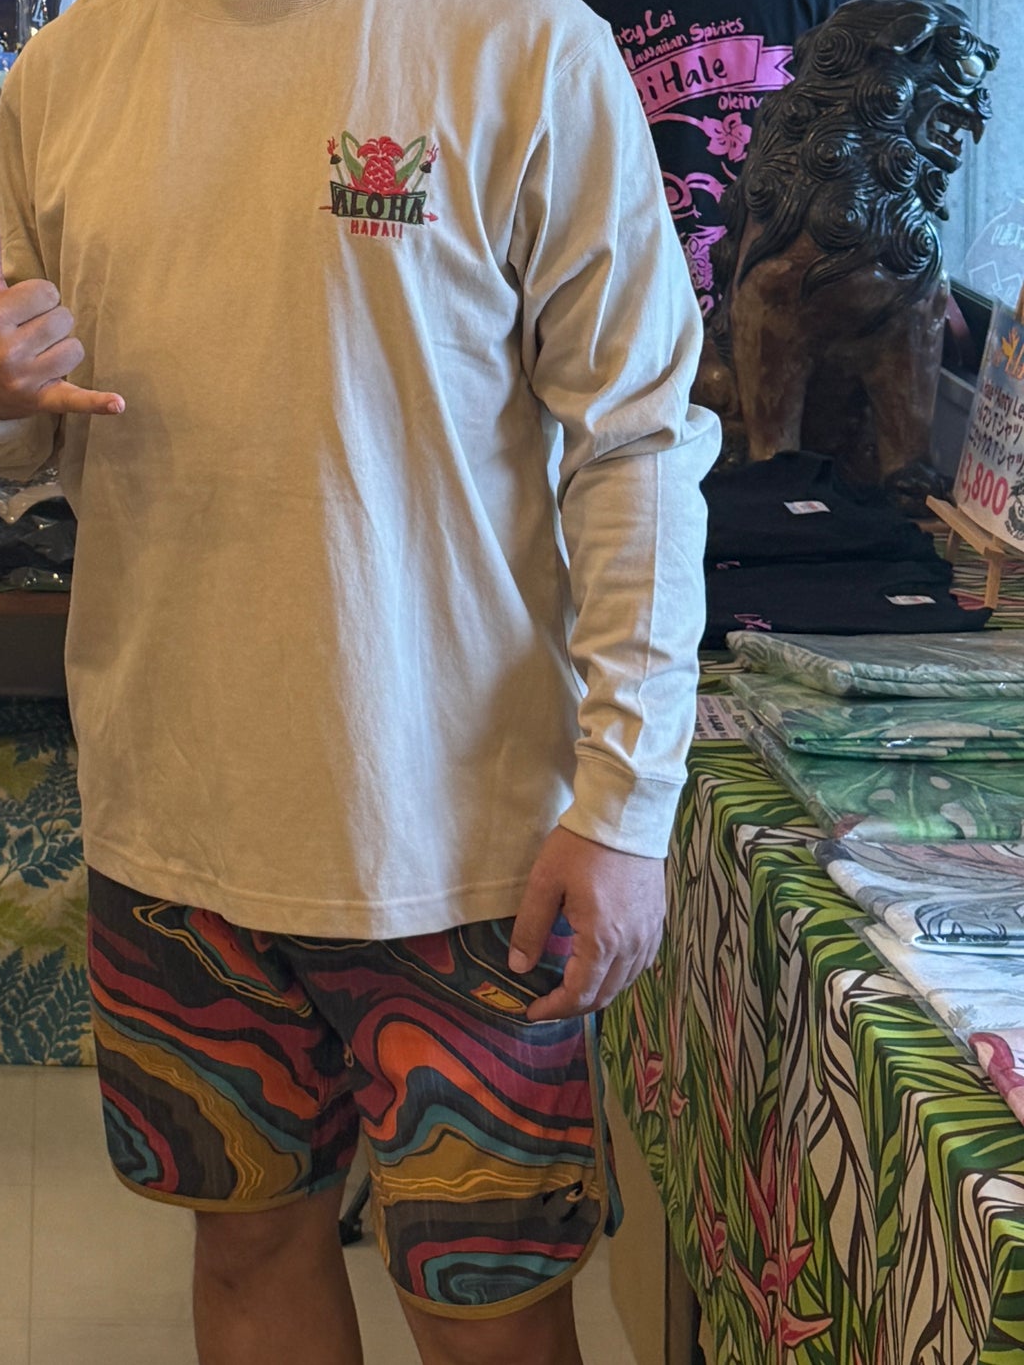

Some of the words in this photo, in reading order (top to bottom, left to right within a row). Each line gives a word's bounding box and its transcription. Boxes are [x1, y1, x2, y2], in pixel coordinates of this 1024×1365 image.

[644, 10, 676, 36] Lei
[689, 18, 745, 42] Spirits
[660, 56, 728, 93] Hale
[332, 190, 425, 225] ALOHA
[351, 219, 403, 238] HAWAII
